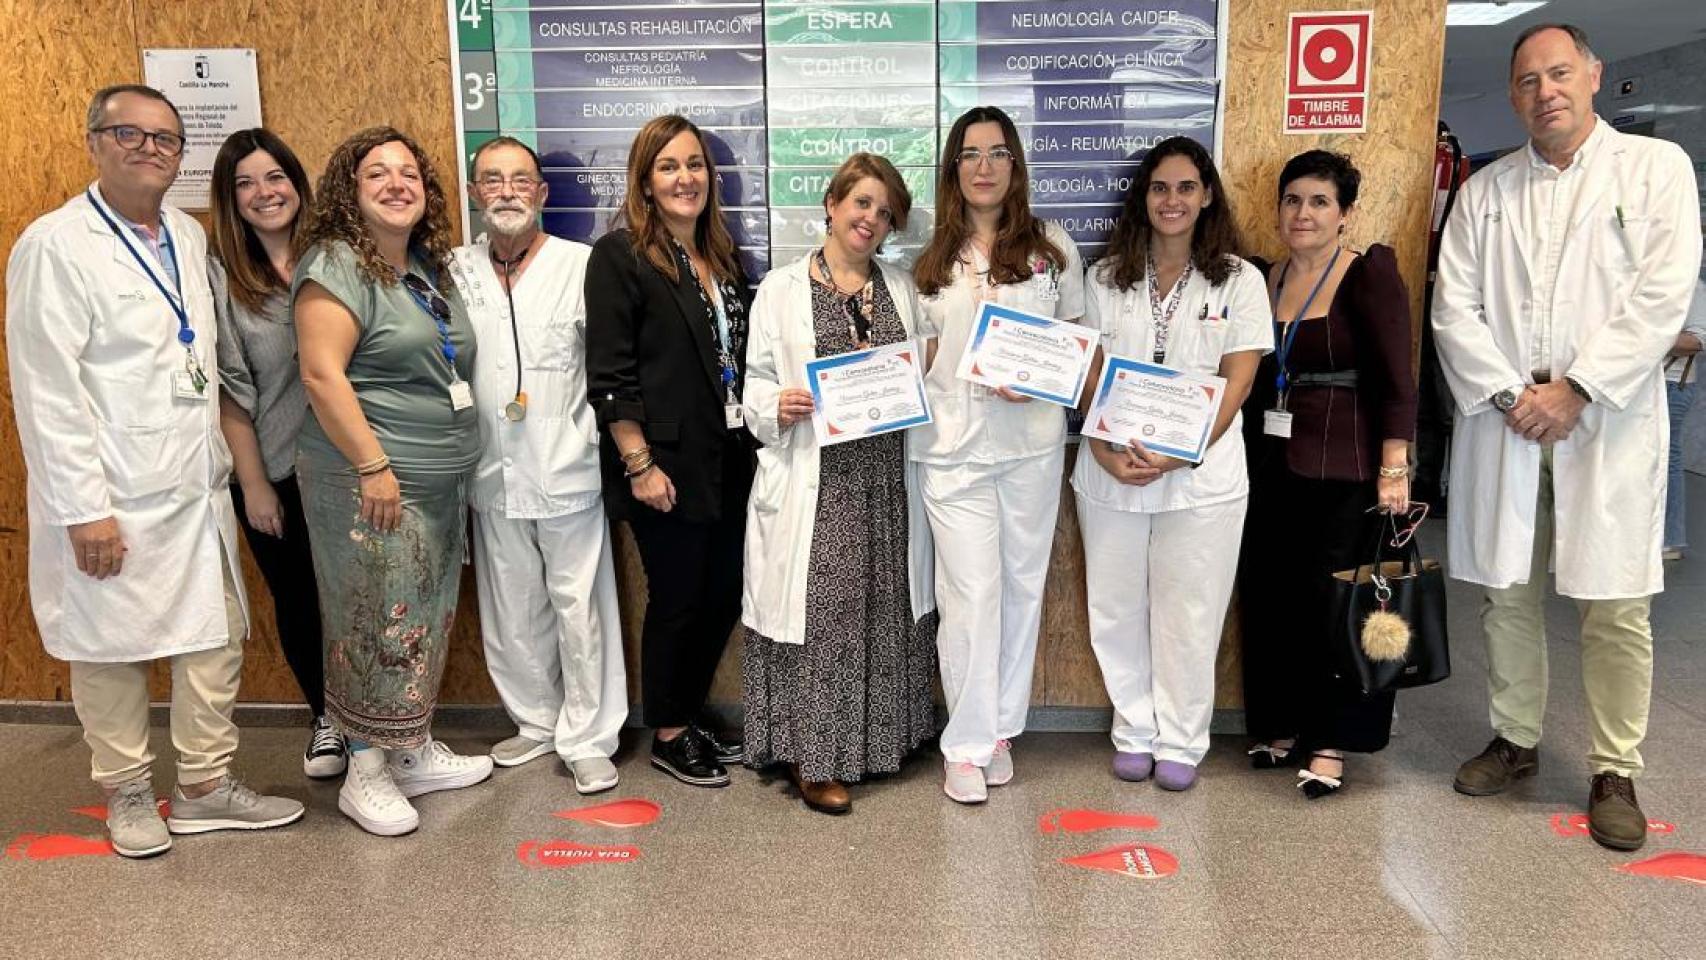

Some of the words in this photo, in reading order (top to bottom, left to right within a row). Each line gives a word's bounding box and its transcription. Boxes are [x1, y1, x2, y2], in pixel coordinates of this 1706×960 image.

[539, 21, 627, 37] CONSULTAS
[631, 16, 753, 35] REHABILITACIÓN
[807, 11, 893, 30] ESPERA
[1012, 8, 1114, 28] NEUMOLOGÍA
[1121, 10, 1178, 26] CAIDER
[584, 51, 648, 63] CONSULTAS
[651, 49, 708, 62] PEDIATRÍA
[1006, 51, 1115, 71] CODIFICACIÓN
[1124, 50, 1184, 67] CLÍNICA
[611, 63, 681, 75] NEFROLOGÍA
[801, 57, 902, 75] CONTROL
[595, 76, 647, 87] MEDICINA
[650, 75, 697, 86] INTERNA
[1302, 100, 1350, 112] TIMBRE
[1288, 114, 1305, 127] DE
[1309, 113, 1361, 126] ALARMA
[800, 138, 899, 156] CONTROL
[591, 185, 626, 196] MEDIC
[789, 174, 831, 194] CITA
[1029, 176, 1095, 193] ROLOGÍA
[544, 850, 593, 858] HUELLA
